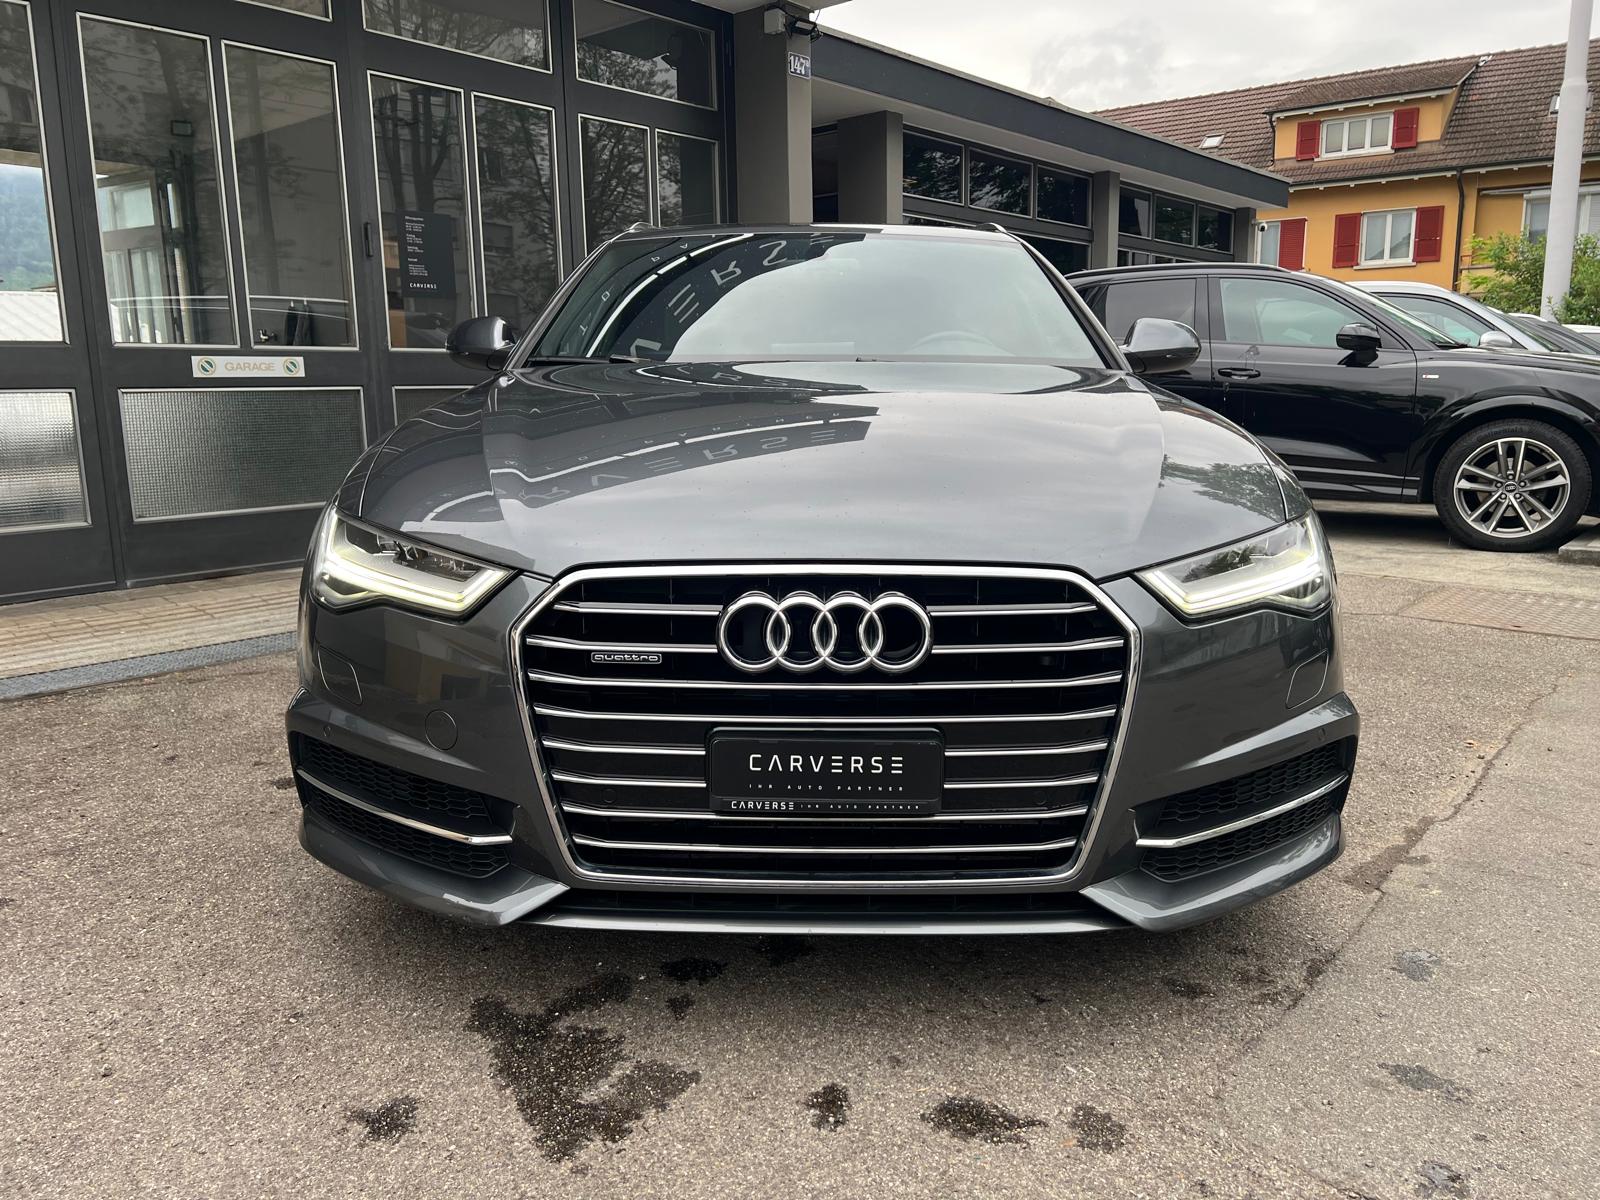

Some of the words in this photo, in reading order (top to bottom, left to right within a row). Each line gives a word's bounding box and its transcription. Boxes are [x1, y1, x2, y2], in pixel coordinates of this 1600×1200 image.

[224, 362, 277, 372] GARAGE
[594, 654, 659, 663] quattro
[750, 754, 903, 773] CARVERSE
[732, 800, 794, 810] CARVERSE
